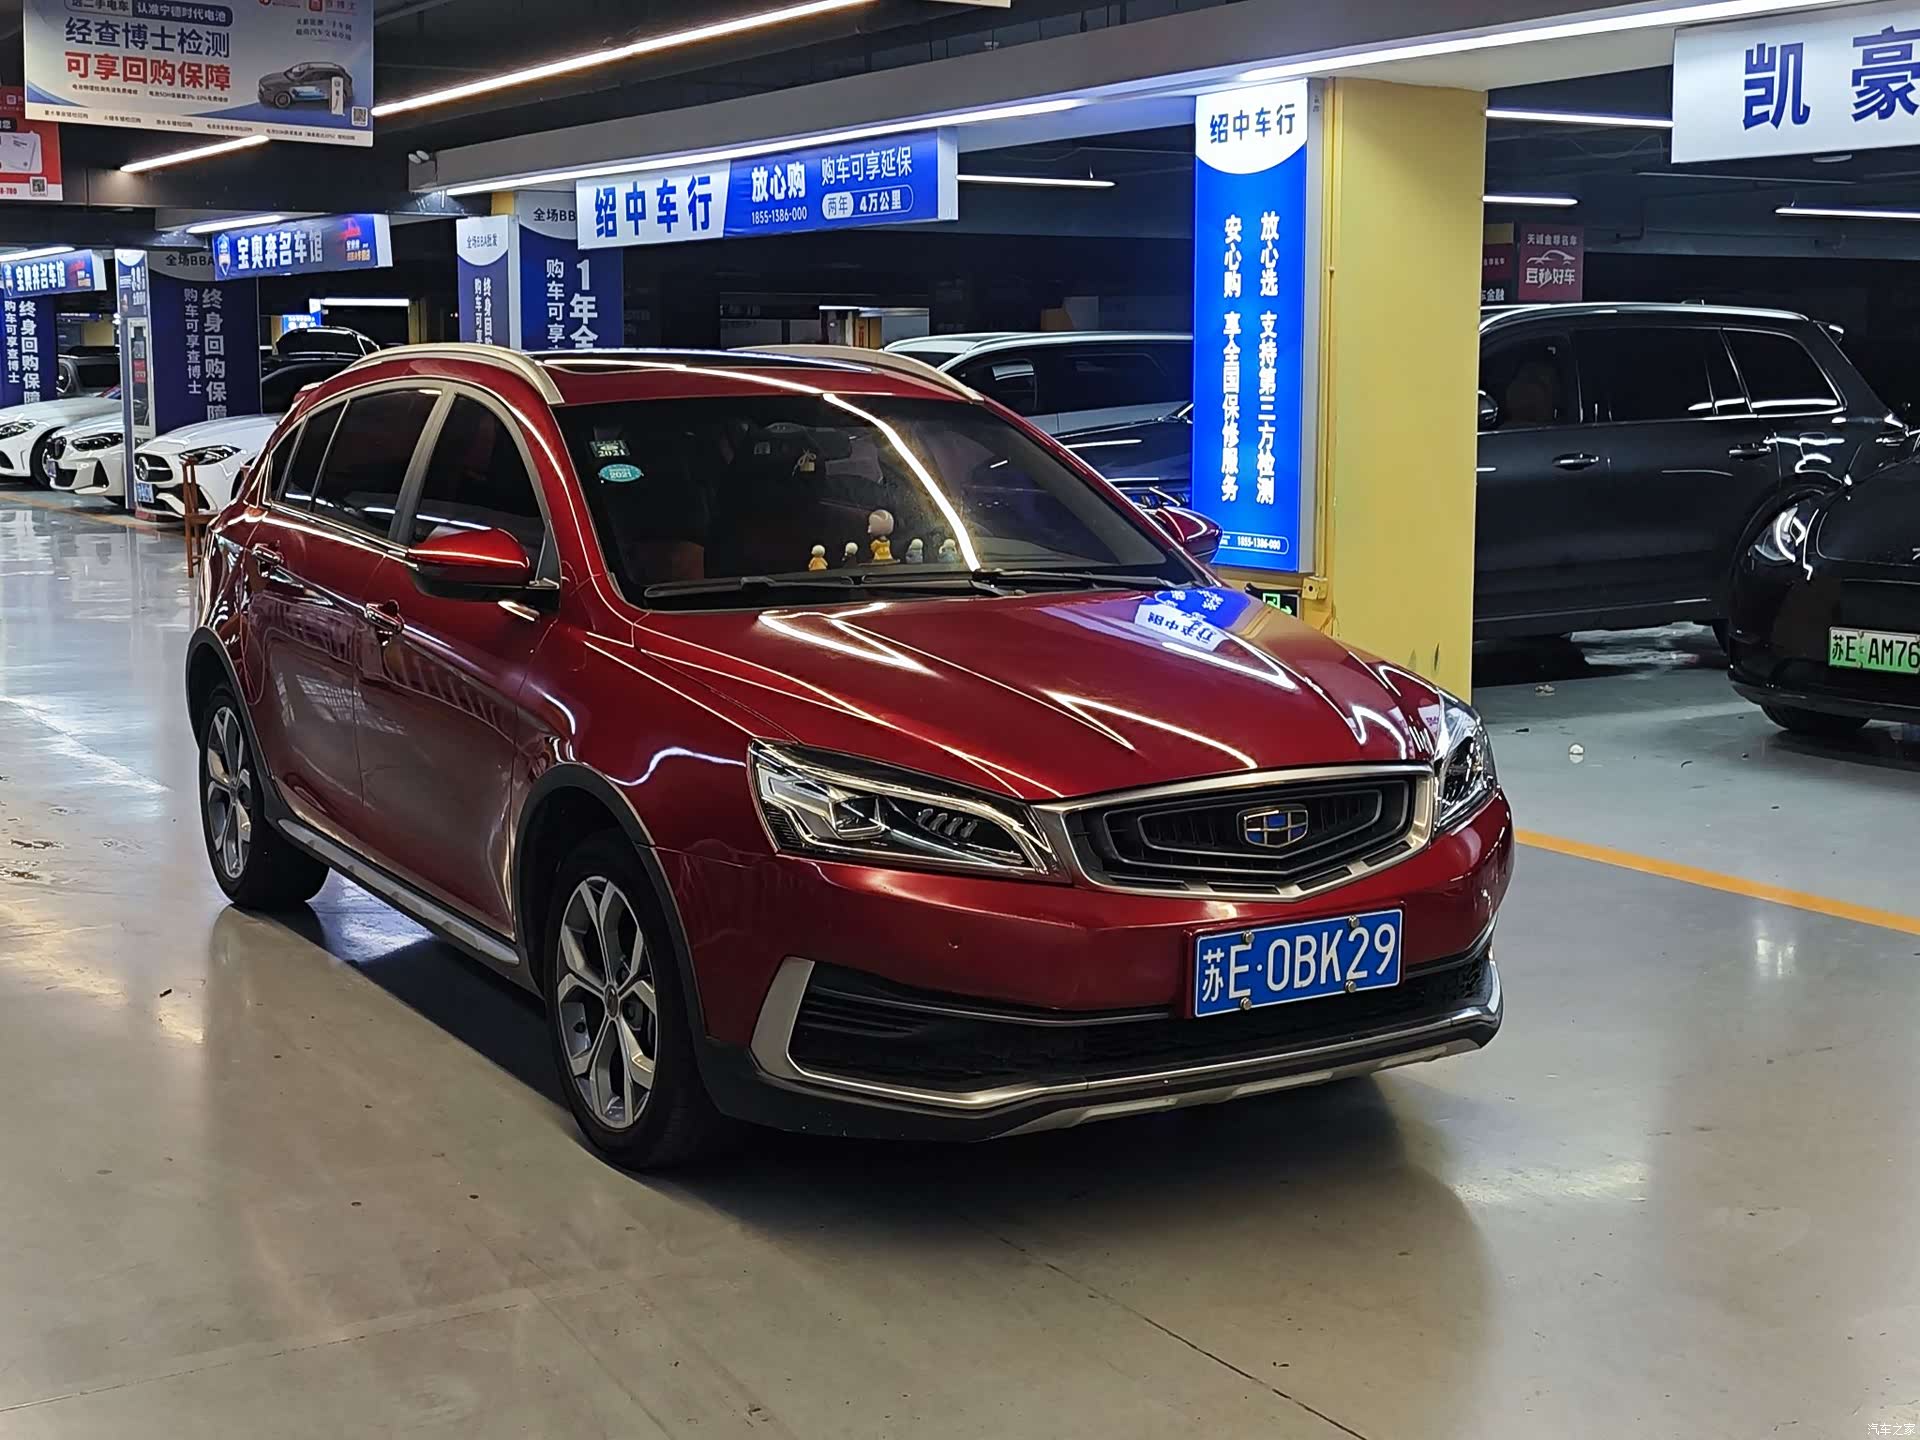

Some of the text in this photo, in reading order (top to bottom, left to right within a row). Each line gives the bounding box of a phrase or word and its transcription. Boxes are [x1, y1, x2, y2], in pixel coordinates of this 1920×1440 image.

[137, 3, 226, 22] 认准宁德时代电池
[65, 16, 230, 58] 经查博士检测
[65, 51, 231, 91] 可享回购保障
[1743, 25, 1920, 131] 凯豪
[1210, 103, 1296, 144] 绍中车行
[751, 161, 807, 203] 放心购
[821, 146, 912, 186] 购车可享延保
[594, 175, 712, 238] 绍中车行
[751, 206, 807, 224] 1855-1386-000
[827, 189, 902, 215] 两年 4万公里
[237, 230, 323, 270] 宝奥奔名车馆
[546, 259, 565, 349] 购车可享
[570, 259, 598, 348] 1年全
[4, 301, 20, 383] 购车可享查博士
[184, 288, 202, 395] 购车可享查博士
[1221, 214, 1242, 502] 安心购 享全国保修服务
[1256, 211, 1280, 505] 放心选 支持第三方检测
